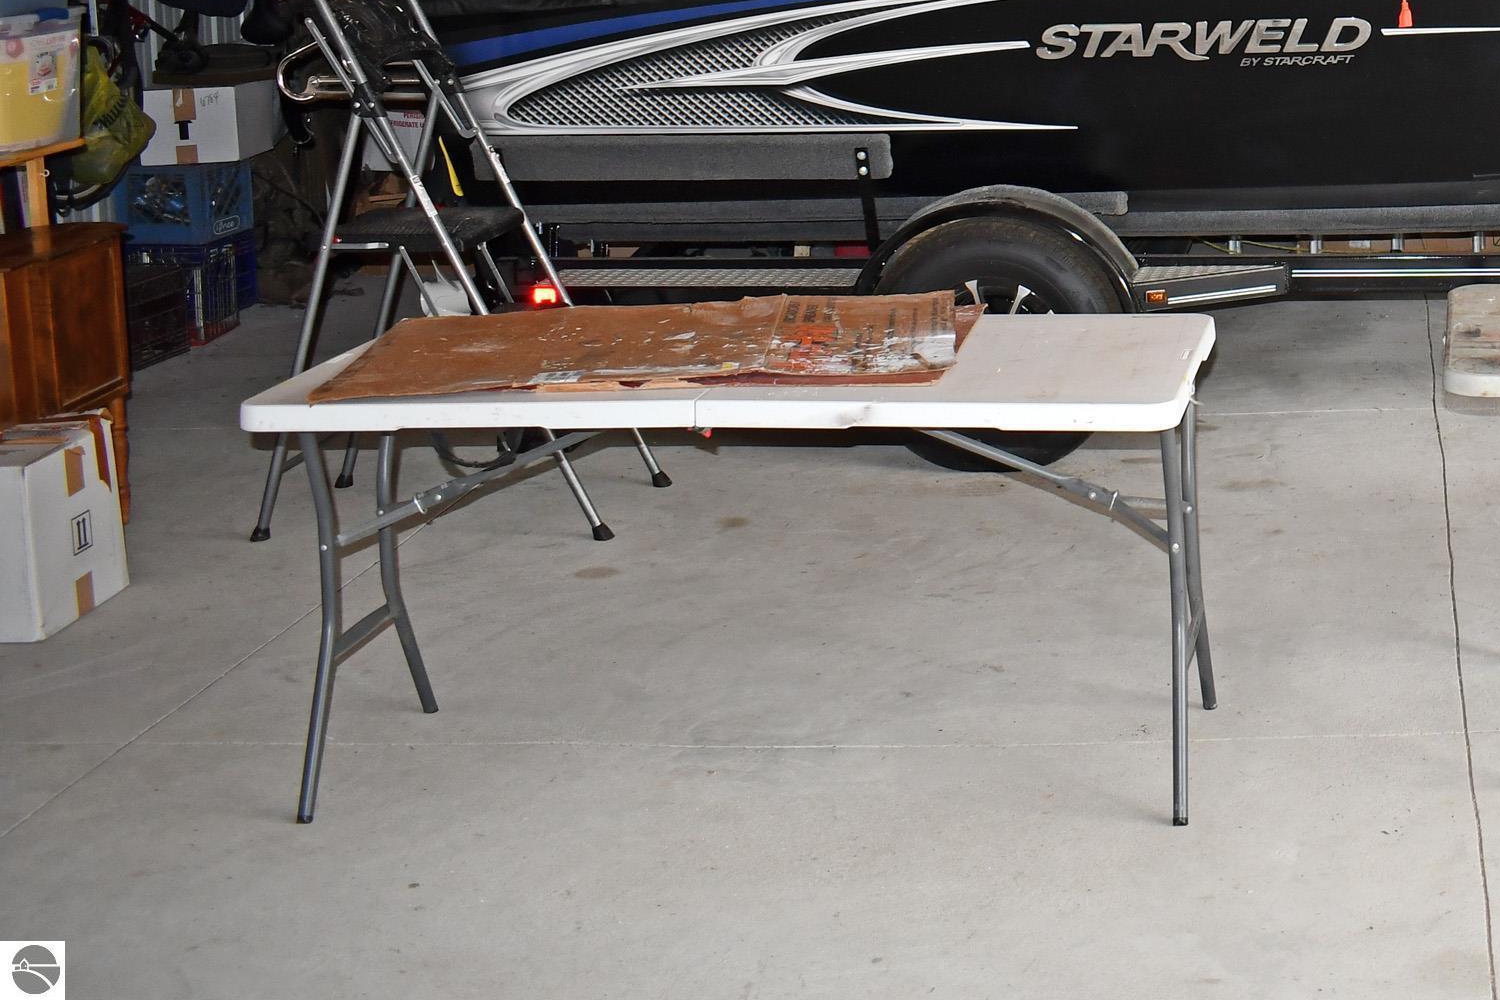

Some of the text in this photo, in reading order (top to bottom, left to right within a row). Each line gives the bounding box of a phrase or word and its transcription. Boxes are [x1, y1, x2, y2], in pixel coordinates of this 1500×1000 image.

[1035, 16, 1372, 61] STARWELD
[1239, 54, 1355, 67] BY STARCRAFT
